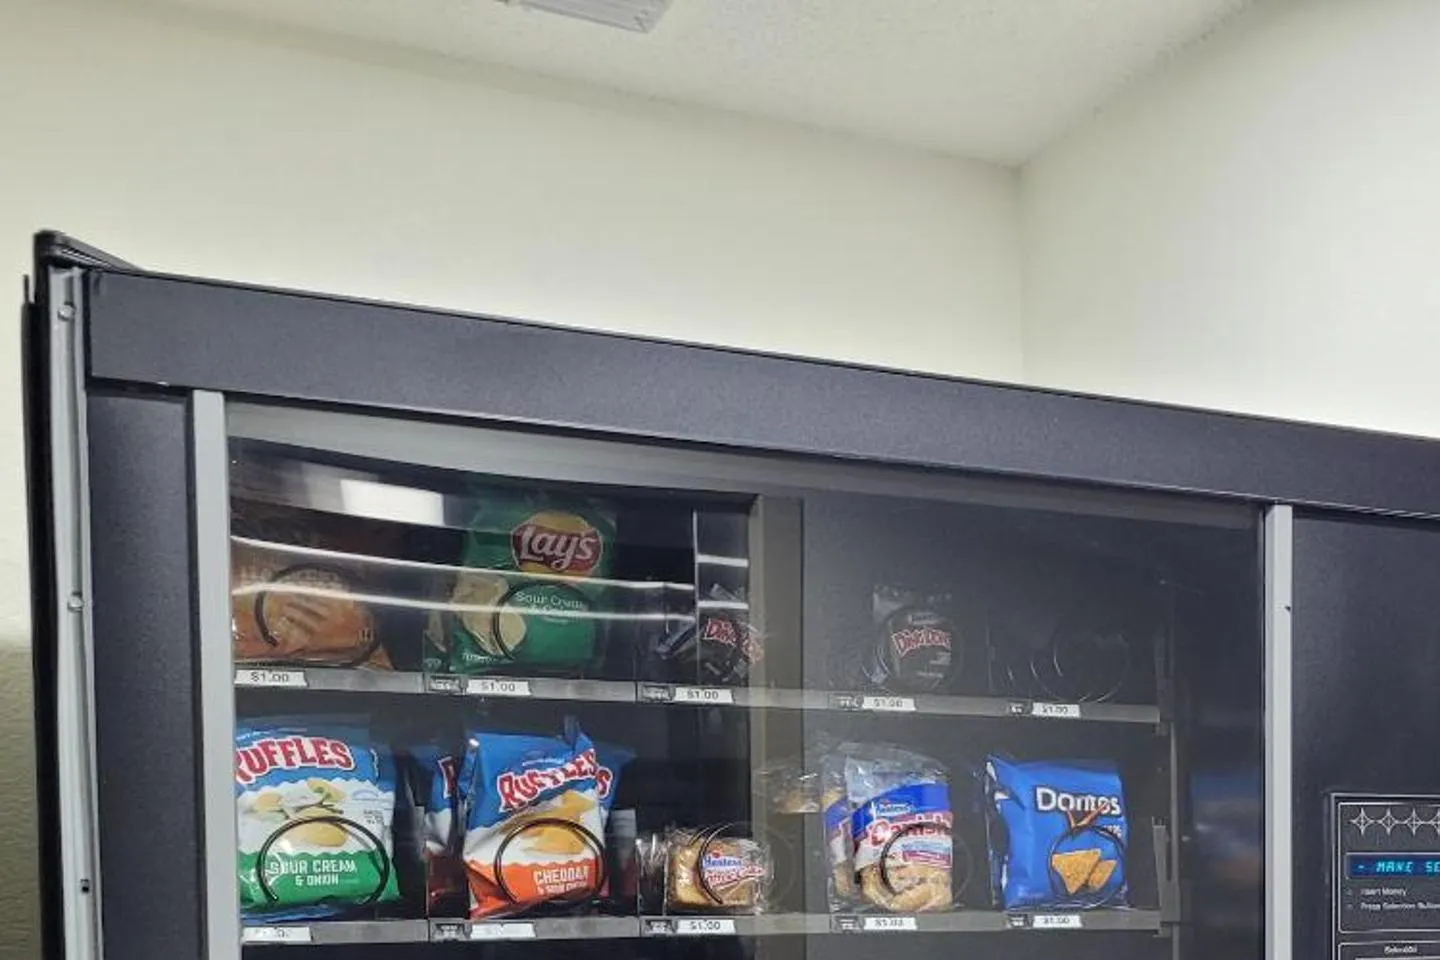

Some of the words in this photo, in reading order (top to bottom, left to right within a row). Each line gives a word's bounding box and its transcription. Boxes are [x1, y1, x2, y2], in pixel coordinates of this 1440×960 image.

[250, 672, 290, 682] $1.00
[480, 683, 516, 693] $1.00
[686, 690, 719, 699] $1.00
[1036, 787, 1121, 814] Doritos
[269, 860, 307, 874] SOUR
[313, 859, 357, 873] CREAM
[1376, 860, 1413, 873] MAKE
[690, 921, 721, 931] $1.00
